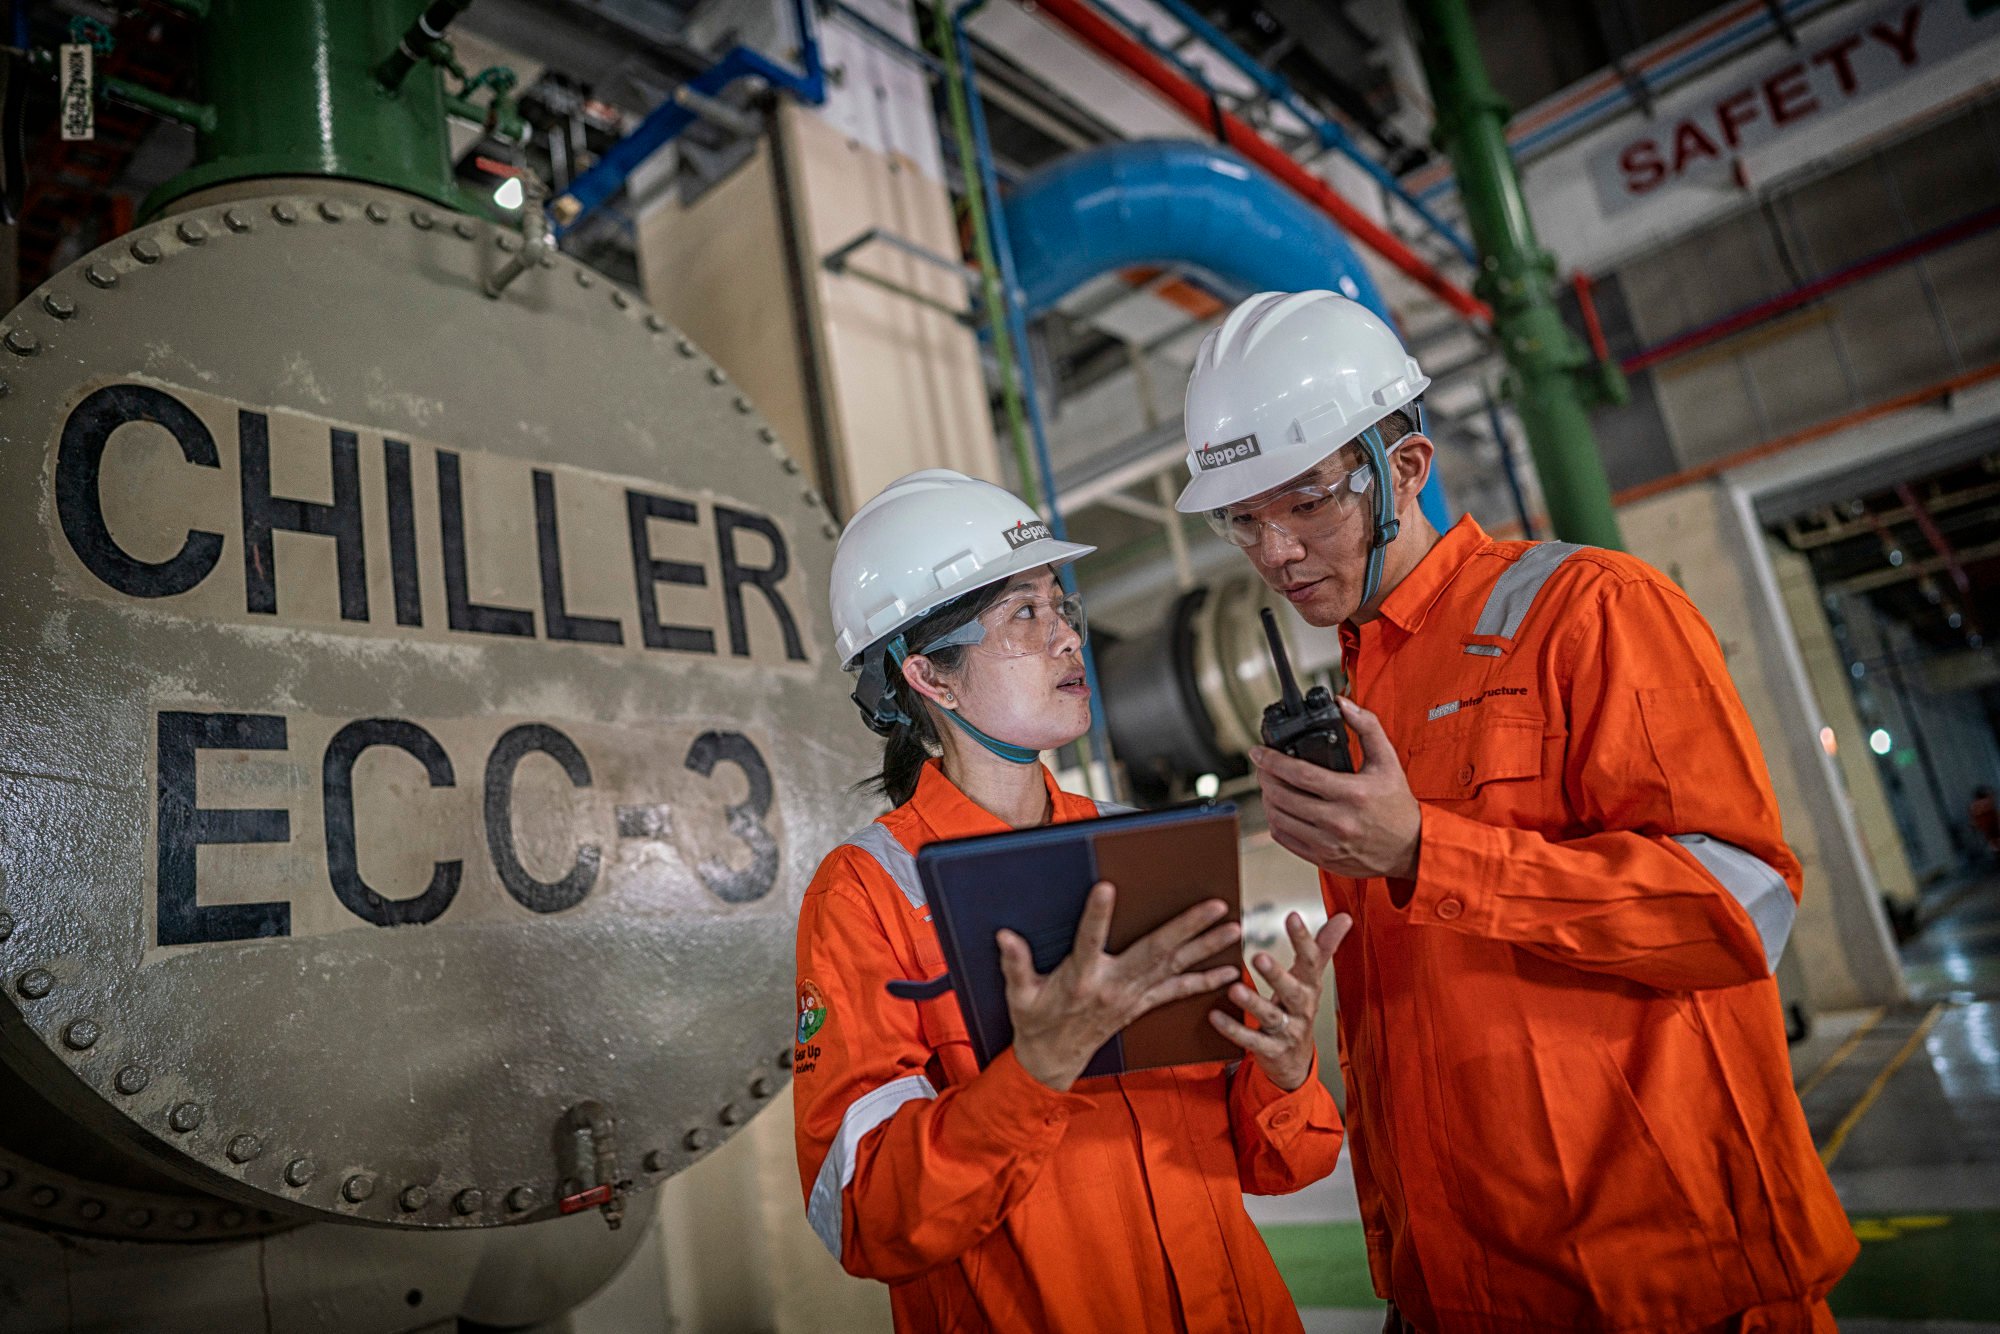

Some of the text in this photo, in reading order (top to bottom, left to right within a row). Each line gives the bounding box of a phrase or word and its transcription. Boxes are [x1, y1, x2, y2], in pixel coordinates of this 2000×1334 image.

[1619, 4, 1922, 195] SAFETY
[1198, 438, 1256, 467] Keppel
[55, 384, 808, 661] CHILLER
[1007, 521, 1051, 545] Keppe
[1460, 687, 1528, 708] Infraructure
[157, 711, 779, 947] ECC-3
[808, 1045, 821, 1060] Up
